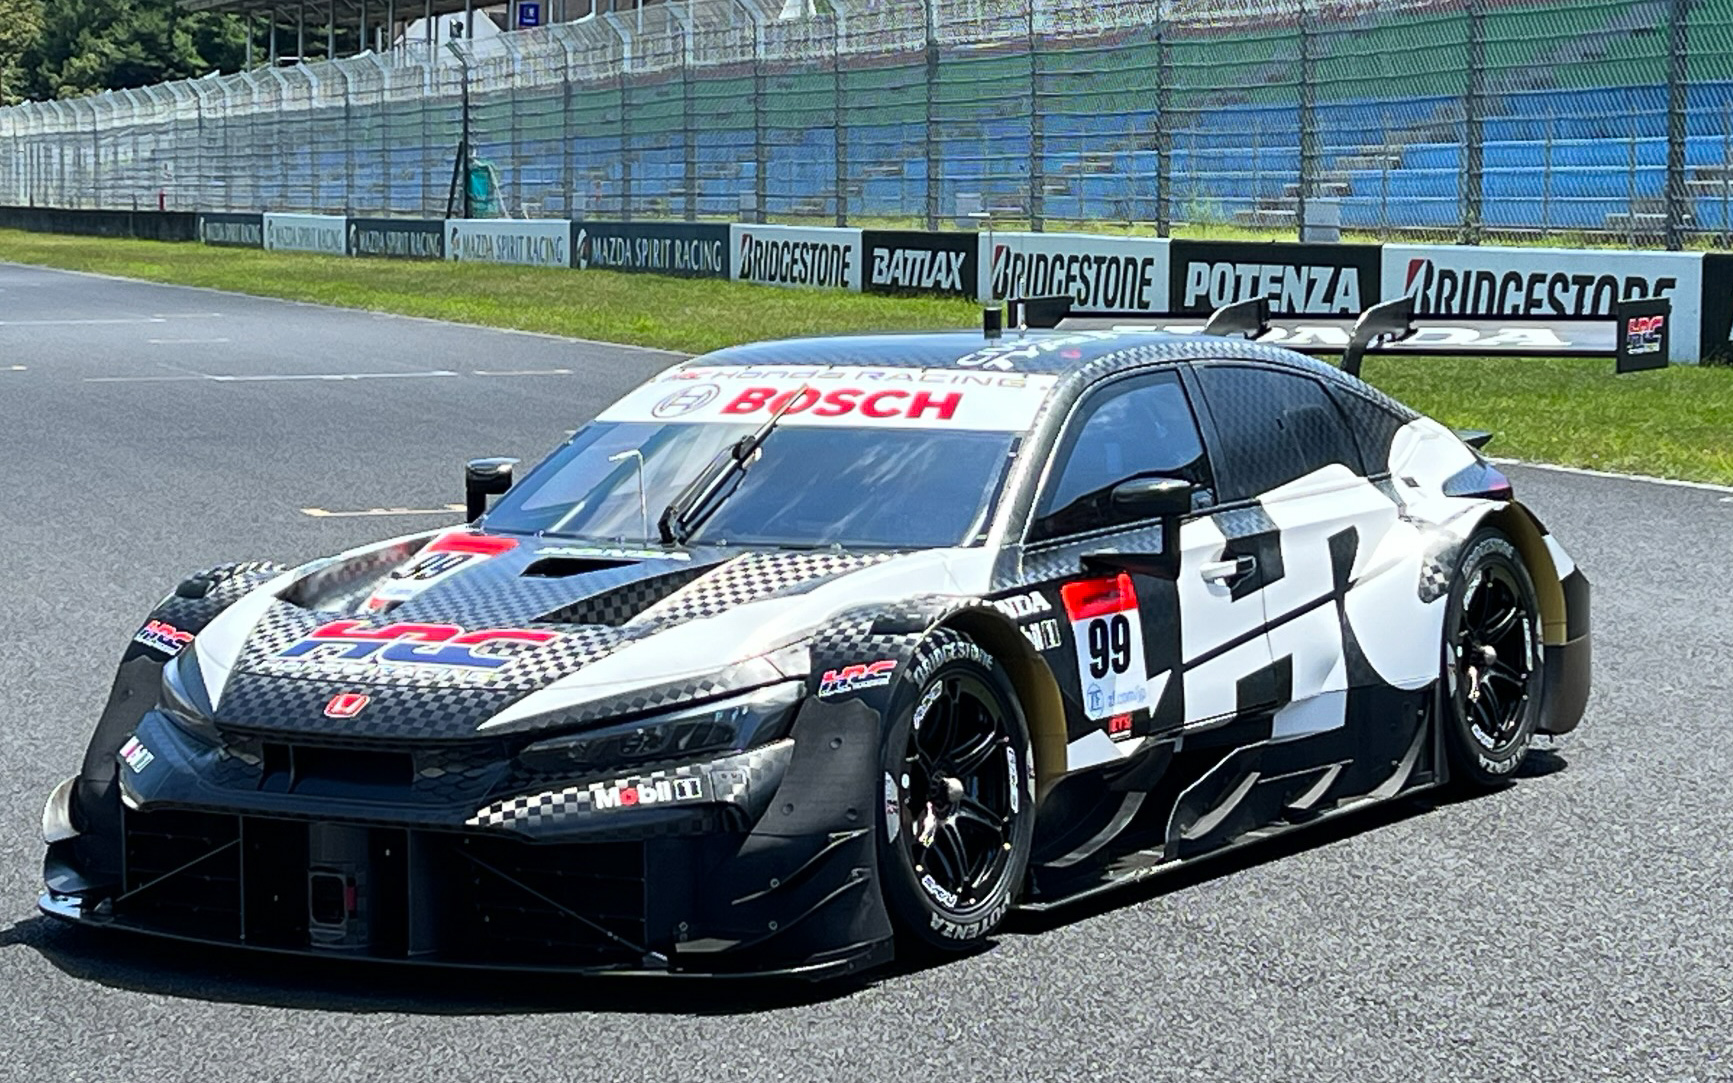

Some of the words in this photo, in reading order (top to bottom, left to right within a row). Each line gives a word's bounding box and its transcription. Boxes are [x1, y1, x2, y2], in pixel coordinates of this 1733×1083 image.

[462, 235, 492, 259] MAZDA
[496, 235, 524, 260] SPIRIT
[526, 235, 563, 263] RACING
[592, 237, 633, 266] MAZDA
[635, 238, 671, 269] SPIRIT
[675, 239, 722, 272] RACING
[739, 233, 852, 287] BRIDGESTONE
[872, 247, 966, 290] BATTLAX
[1184, 261, 1361, 313] POTENZA
[855, 371, 1027, 388] RACING
[719, 386, 963, 420] BOSCH
[983, 590, 1052, 619] NDA
[274, 619, 562, 671] HRC
[912, 641, 994, 688] BRIDGESTONE
[1089, 615, 1131, 679] 99
[819, 660, 898, 693] HRC
[594, 780, 672, 810] Mobil
[930, 890, 1011, 940] POTENZA
